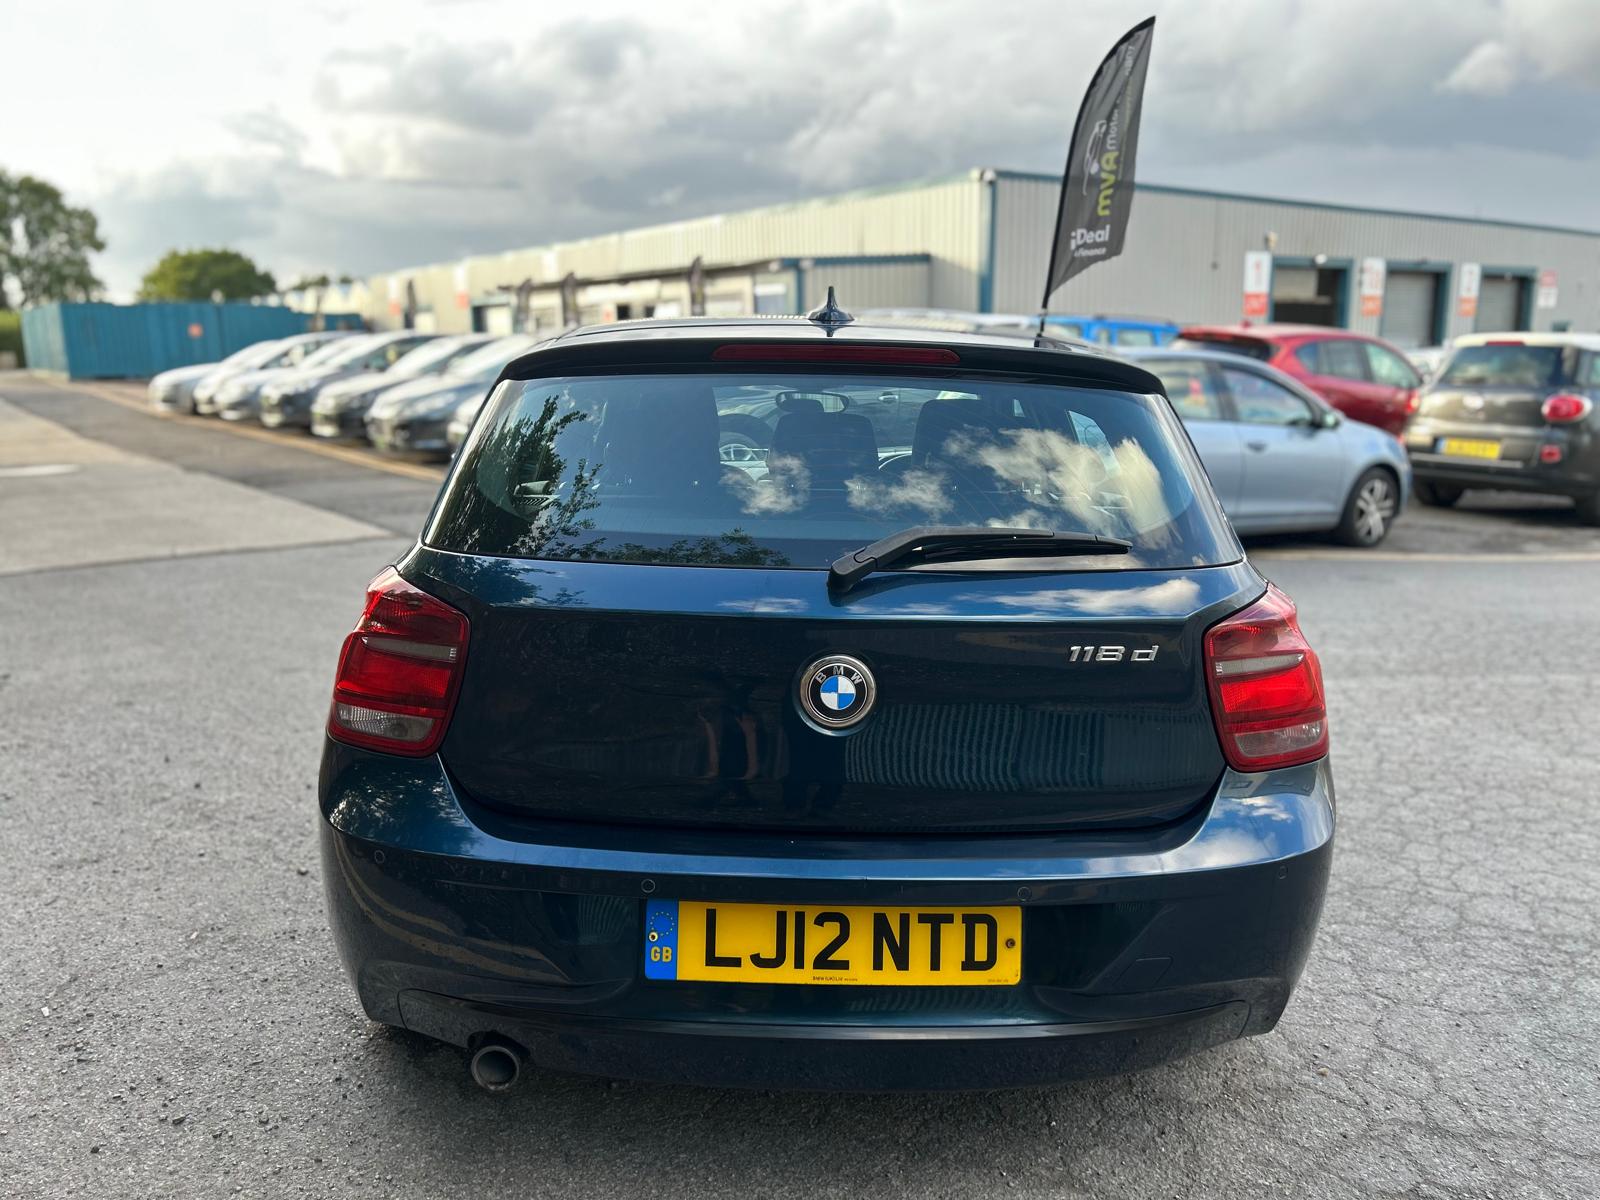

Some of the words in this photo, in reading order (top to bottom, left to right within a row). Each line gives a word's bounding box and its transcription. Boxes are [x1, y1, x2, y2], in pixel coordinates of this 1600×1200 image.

[1070, 224, 1111, 250] iDeal
[1069, 645, 1126, 662] 118
[1130, 645, 1160, 661] d
[815, 665, 863, 684] BMW
[705, 908, 851, 970] LJ12
[872, 912, 998, 972] NTD
[651, 946, 672, 962] GB
